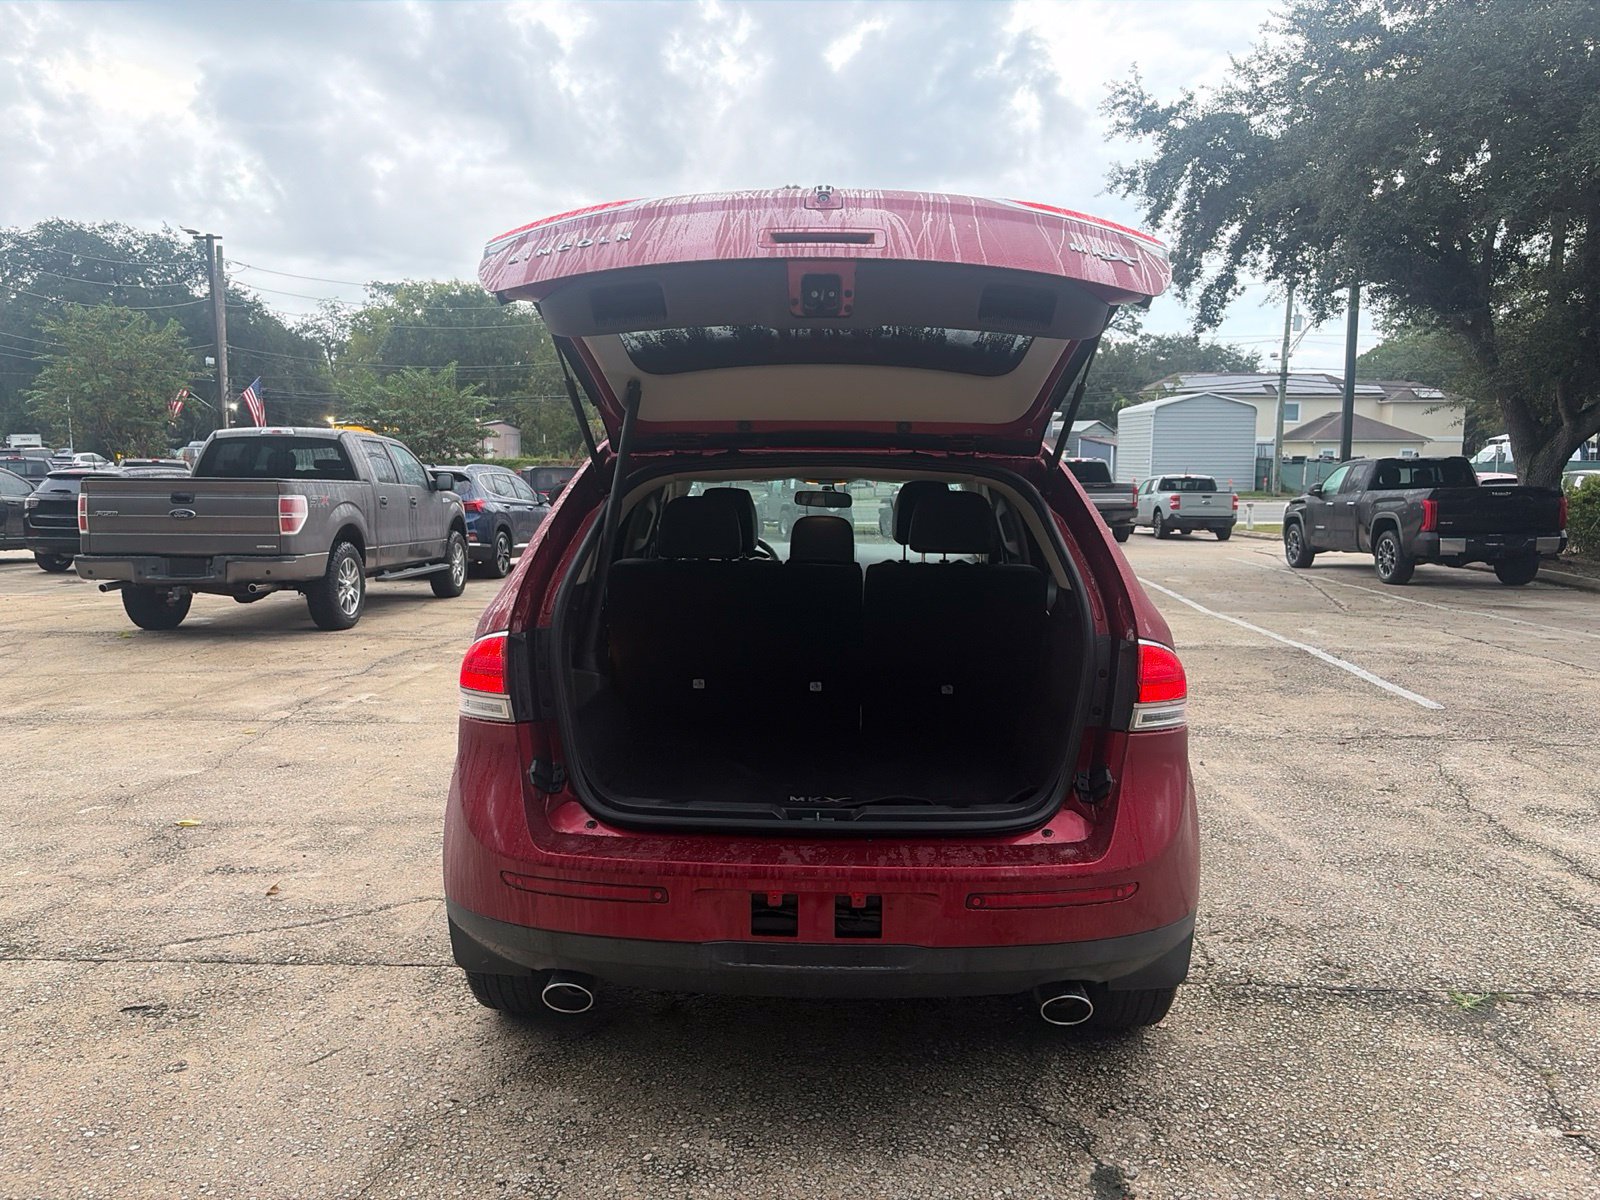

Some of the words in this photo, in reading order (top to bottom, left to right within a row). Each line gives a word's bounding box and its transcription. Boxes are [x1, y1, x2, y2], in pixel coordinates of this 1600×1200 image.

[507, 231, 633, 265] LINCOLN
[1068, 241, 1140, 267] MKX
[789, 795, 852, 803] MKX
